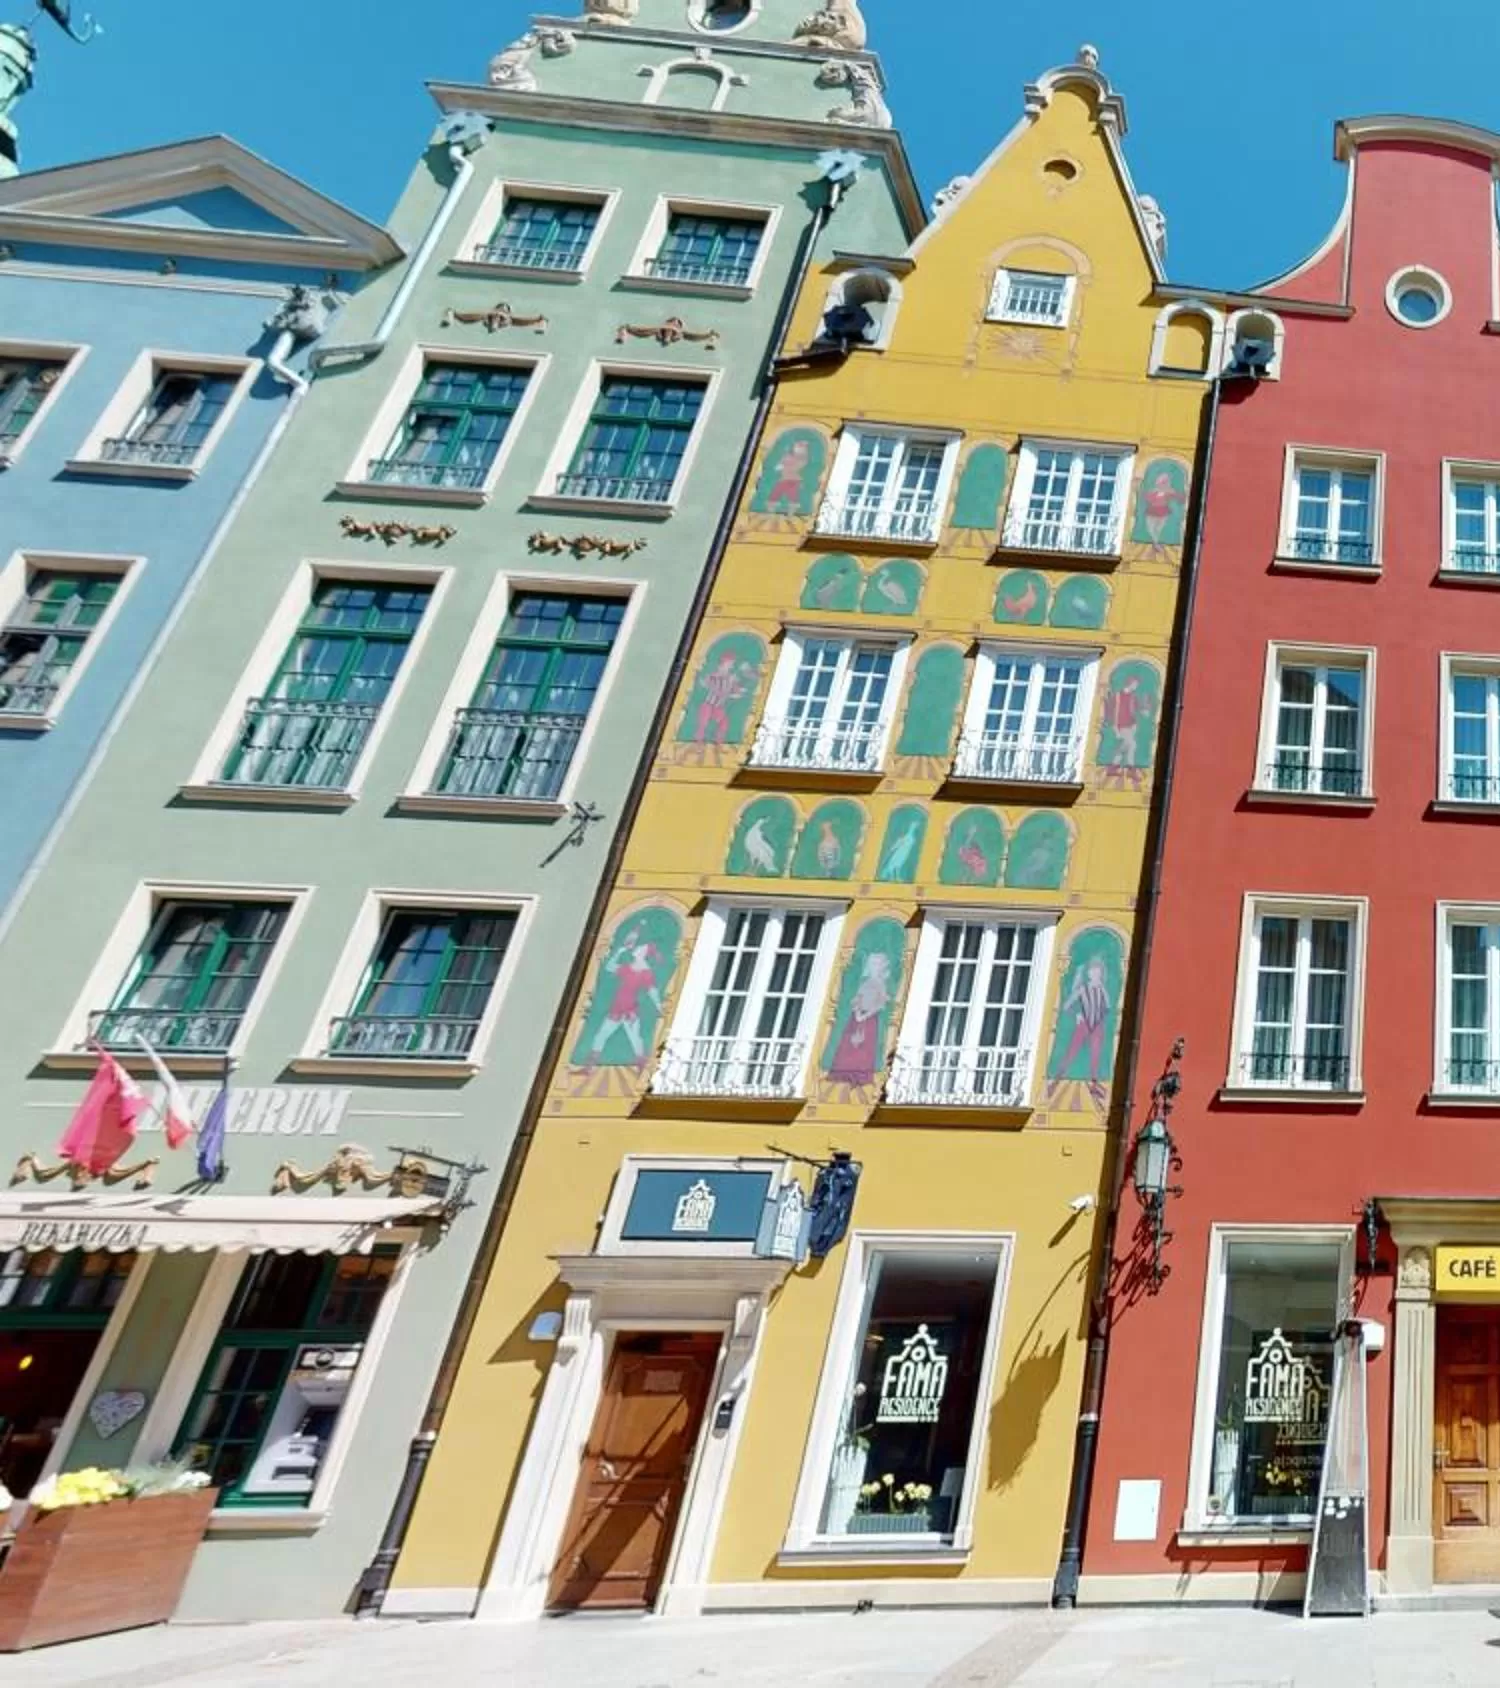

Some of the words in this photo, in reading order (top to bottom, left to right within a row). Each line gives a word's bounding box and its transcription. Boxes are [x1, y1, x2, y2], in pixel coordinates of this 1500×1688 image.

[1449, 1255, 1497, 1278] CAFÉ
[881, 1356, 948, 1397] FAMA
[1246, 1359, 1305, 1397] FAMA
[879, 1397, 940, 1416] RESIDENCE
[1245, 1397, 1304, 1415] RESIDENCE
